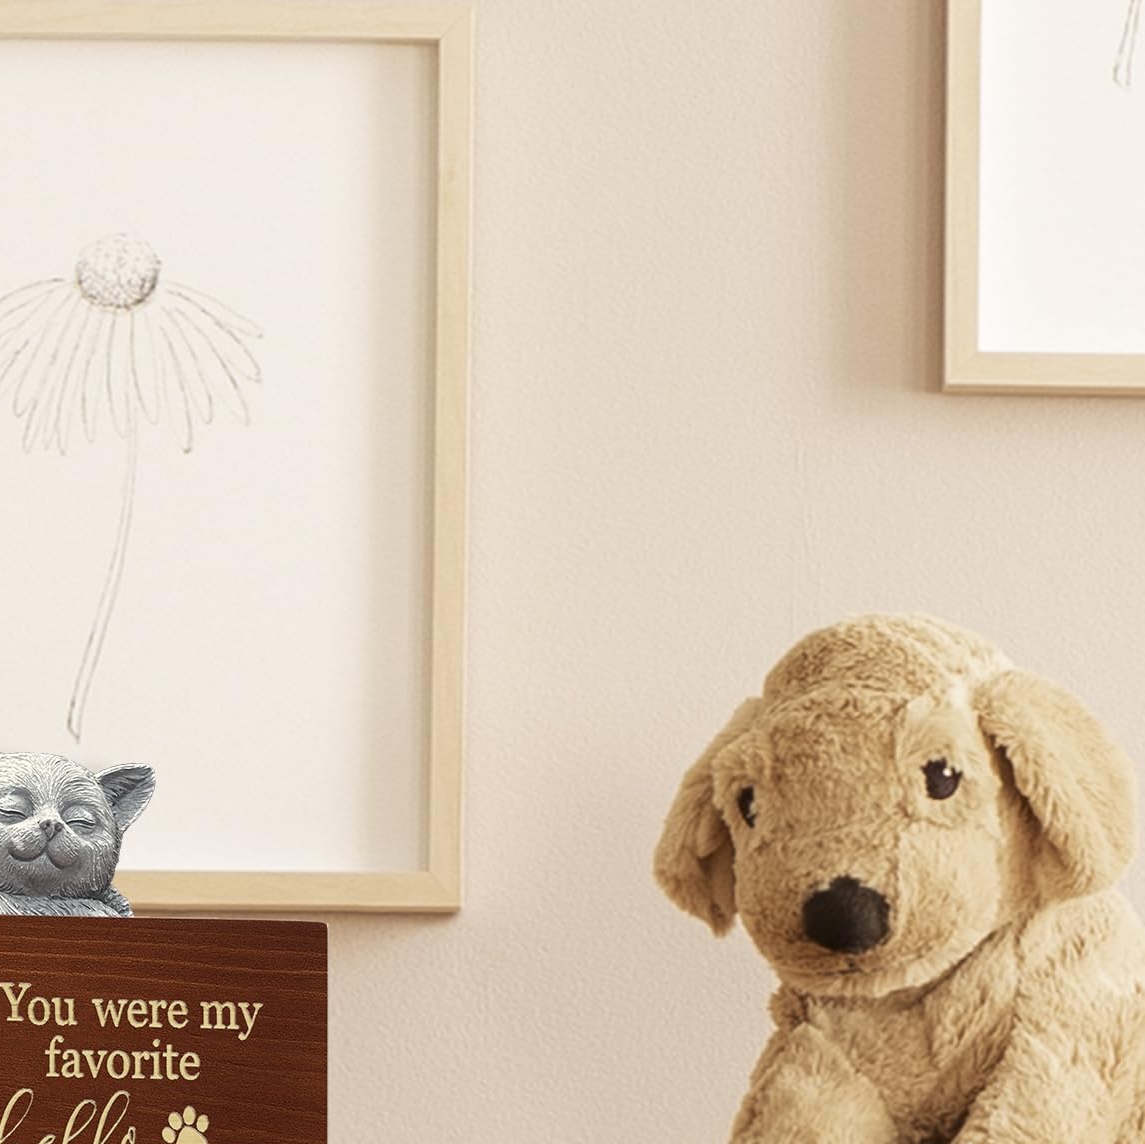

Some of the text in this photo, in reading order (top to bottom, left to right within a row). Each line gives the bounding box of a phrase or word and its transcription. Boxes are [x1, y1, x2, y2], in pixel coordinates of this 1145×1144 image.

[0, 982, 263, 1040] You were my
[45, 1035, 201, 1081] favorite
